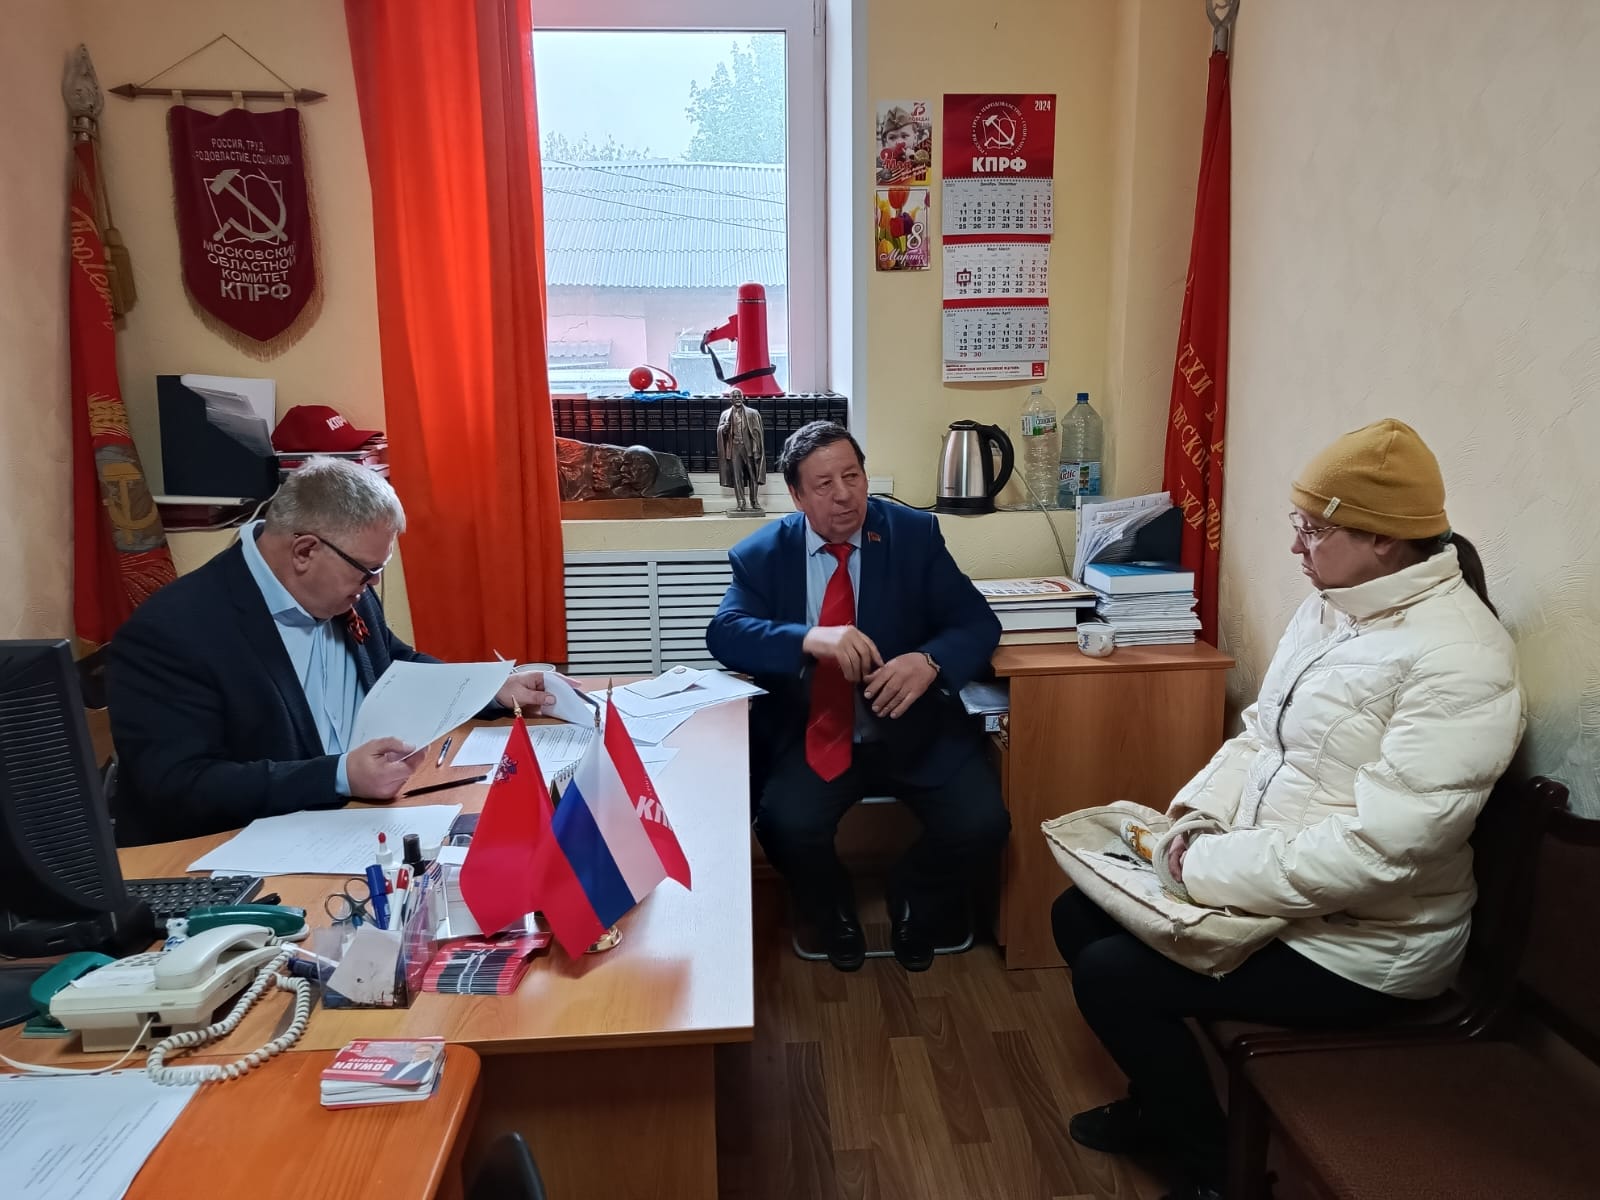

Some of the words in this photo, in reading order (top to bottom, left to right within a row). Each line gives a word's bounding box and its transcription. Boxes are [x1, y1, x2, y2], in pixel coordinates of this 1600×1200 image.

[1034, 100, 1051, 111] 2024
[211, 137, 245, 150] РОССИЯ,
[972, 157, 1027, 172] КПРФ
[907, 222, 924, 250] 8
[879, 248, 925, 264] Марта
[221, 268, 289, 283] КОМИТЕТ
[220, 280, 292, 301] КПРФ
[635, 795, 673, 831] КП
[332, 1062, 394, 1072] НАУМОВ
